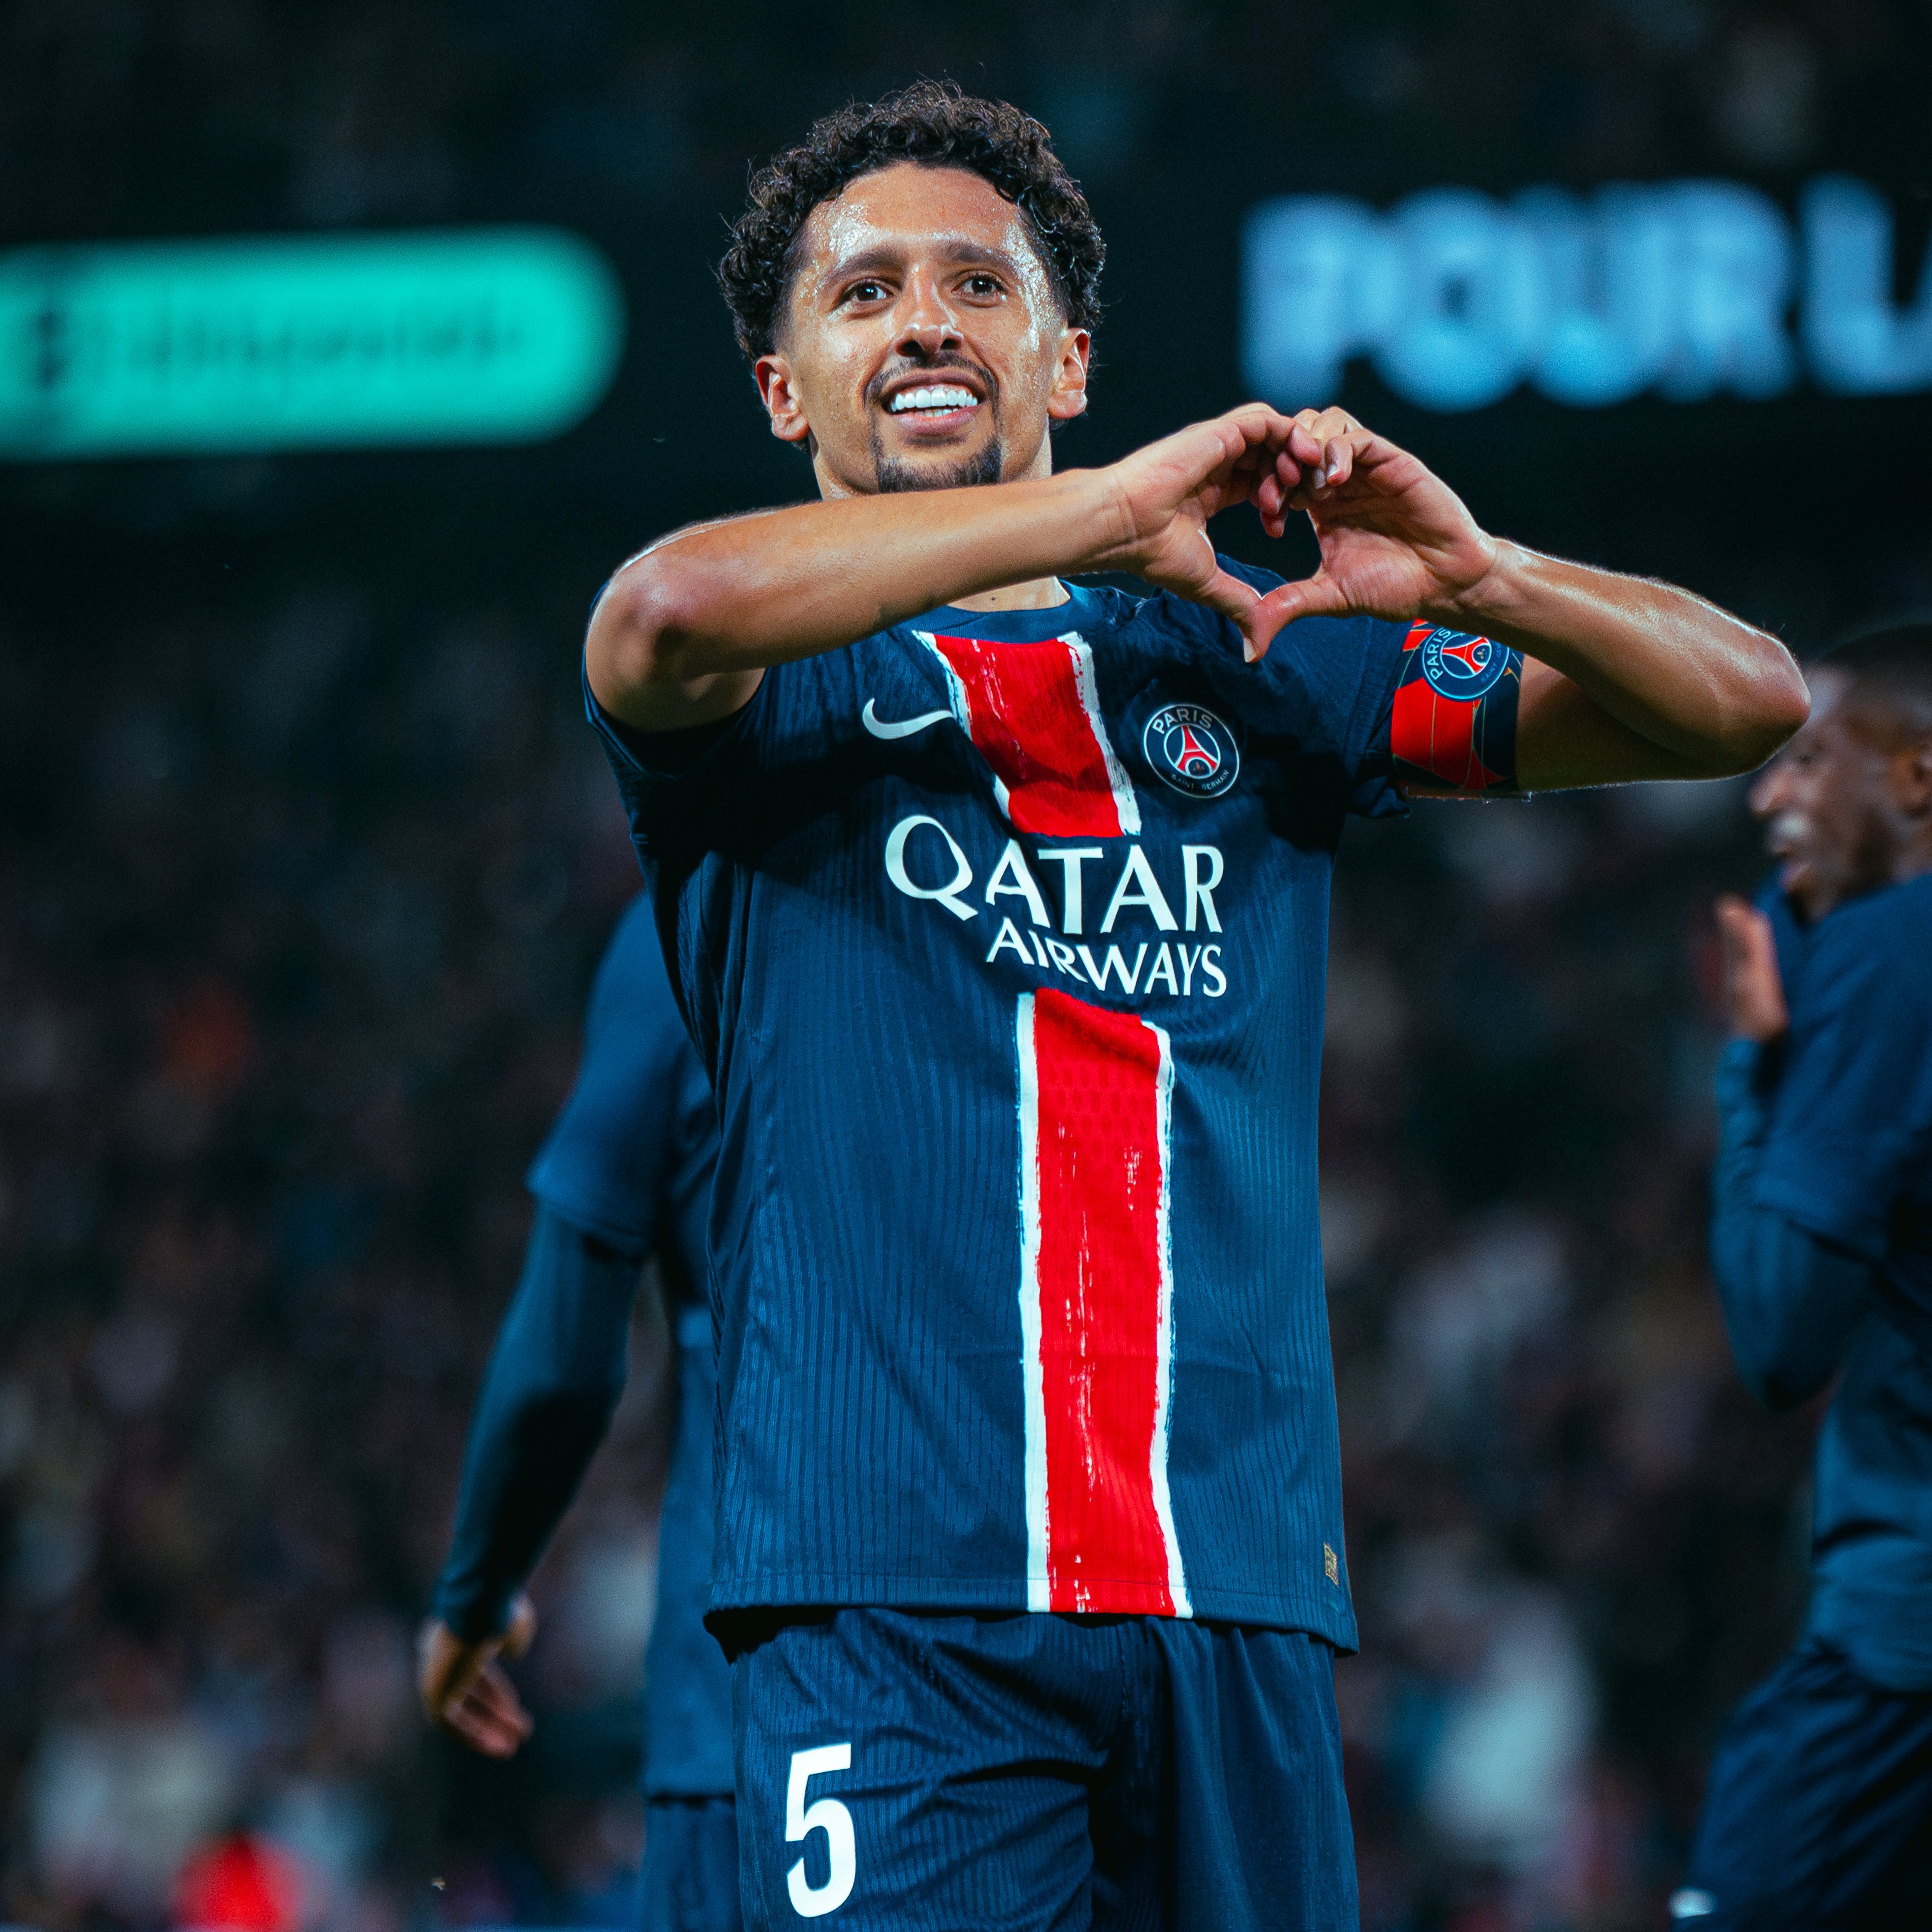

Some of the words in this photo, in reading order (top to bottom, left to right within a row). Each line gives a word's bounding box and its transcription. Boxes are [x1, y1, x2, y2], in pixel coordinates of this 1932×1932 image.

[1242, 183, 1796, 411] POUR
[1798, 170, 1932, 395] L
[1427, 628, 1451, 680] PARIS
[1152, 708, 1213, 735] PARIS
[885, 814, 1224, 935] QATAR
[986, 916, 1227, 998] AIRWAYS
[785, 1741, 856, 1918] 5
